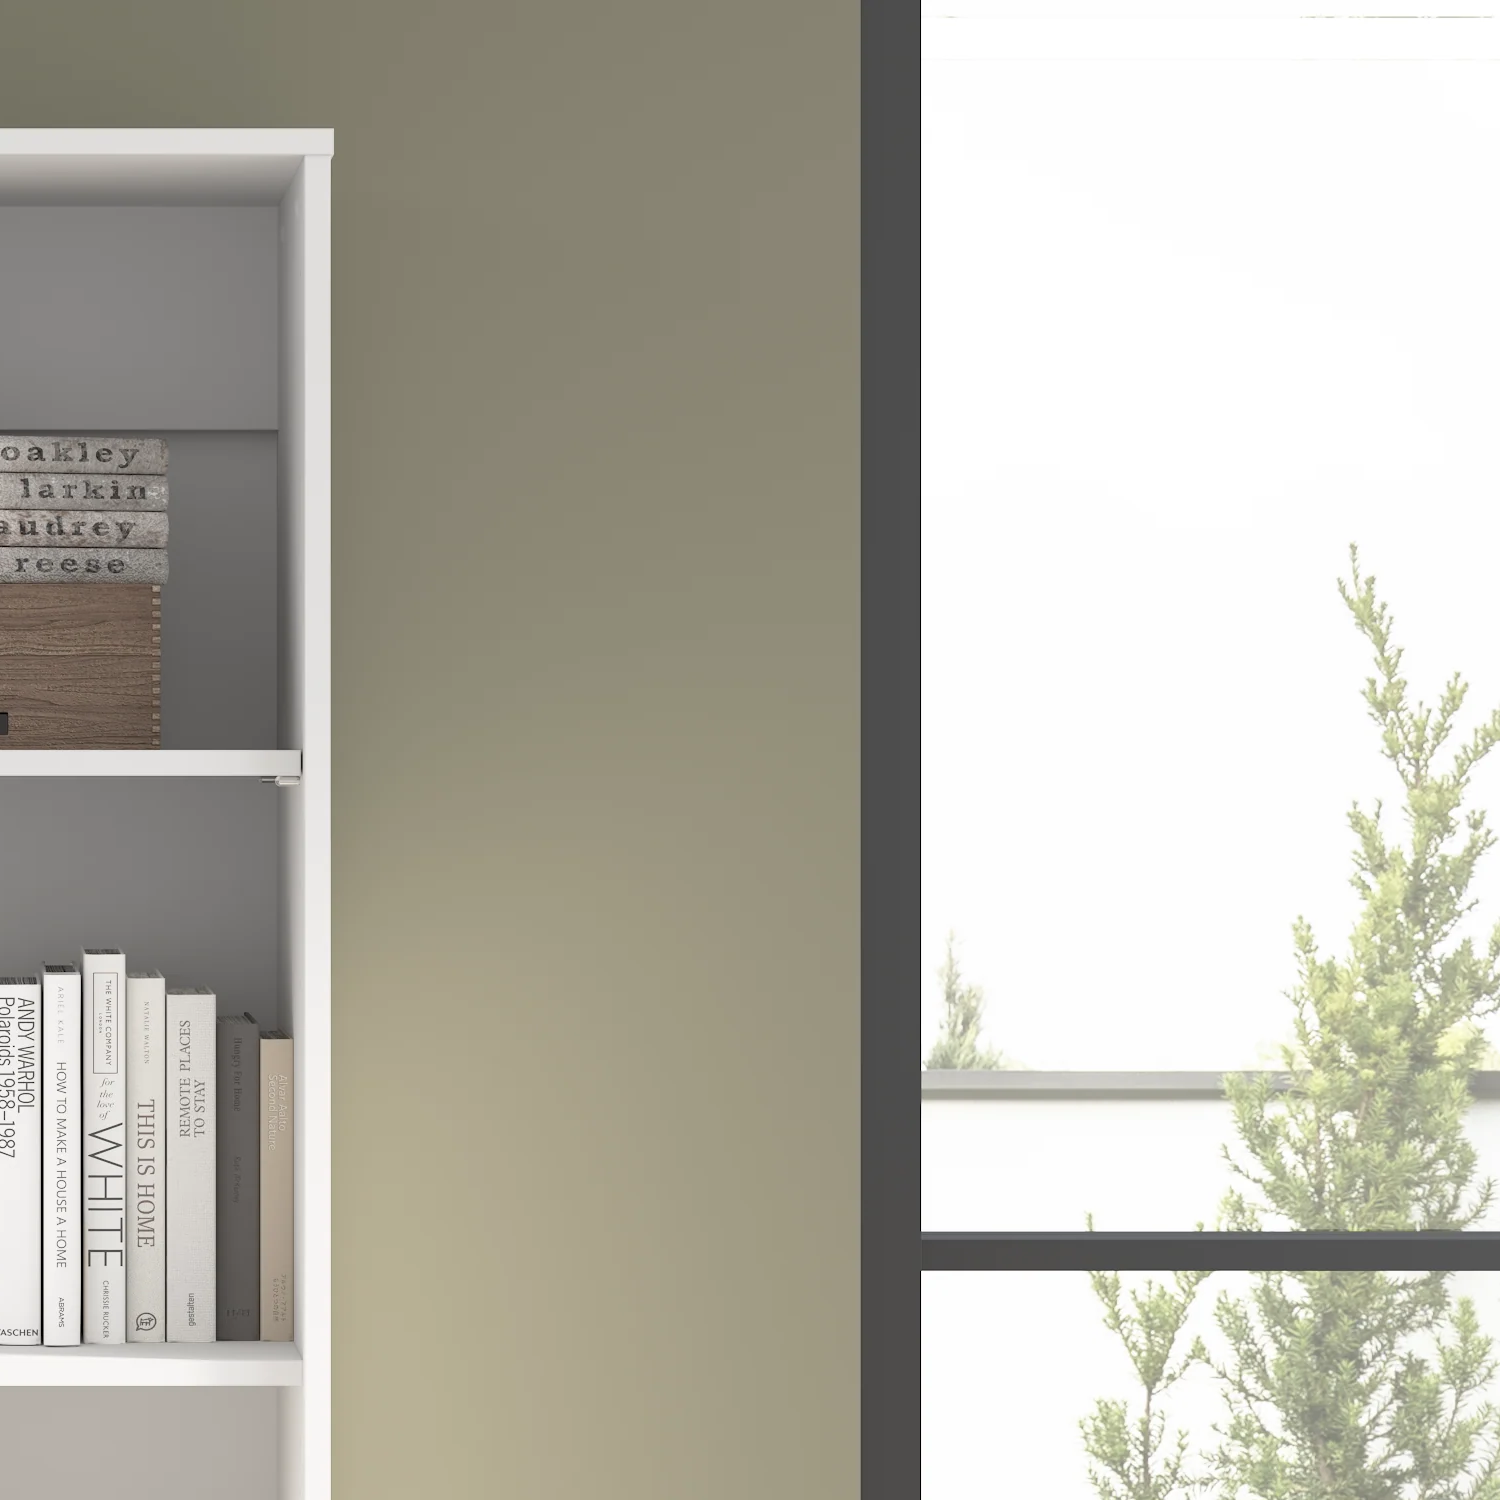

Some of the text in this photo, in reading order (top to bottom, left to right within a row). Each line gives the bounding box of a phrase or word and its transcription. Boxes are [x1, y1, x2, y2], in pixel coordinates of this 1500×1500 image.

[0, 441, 140, 468] oakley
[20, 478, 148, 500] larkin
[15, 555, 127, 574] reese
[57, 986, 65, 1044] ARIEL KALE
[17, 998, 35, 1113] ANDY WARHOL
[100, 1078, 115, 1088] for
[179, 1020, 191, 1138] REMOTE PLACES
[231, 1037, 243, 1112] Hungry For Home
[96, 1100, 115, 1109] love
[98, 1110, 111, 1120] of
[99, 1090, 114, 1098] the
[194, 1080, 206, 1138] TO STAY
[268, 1074, 278, 1151] Second Nature
[278, 1074, 289, 1132] Alvar Aalto
[56, 1062, 67, 1268] HOW TO MAKE A HOUSE A HOME
[137, 1098, 155, 1248] THIS IS HOME
[88, 1122, 123, 1267] WHITE
[187, 1293, 195, 1326] gestalten
